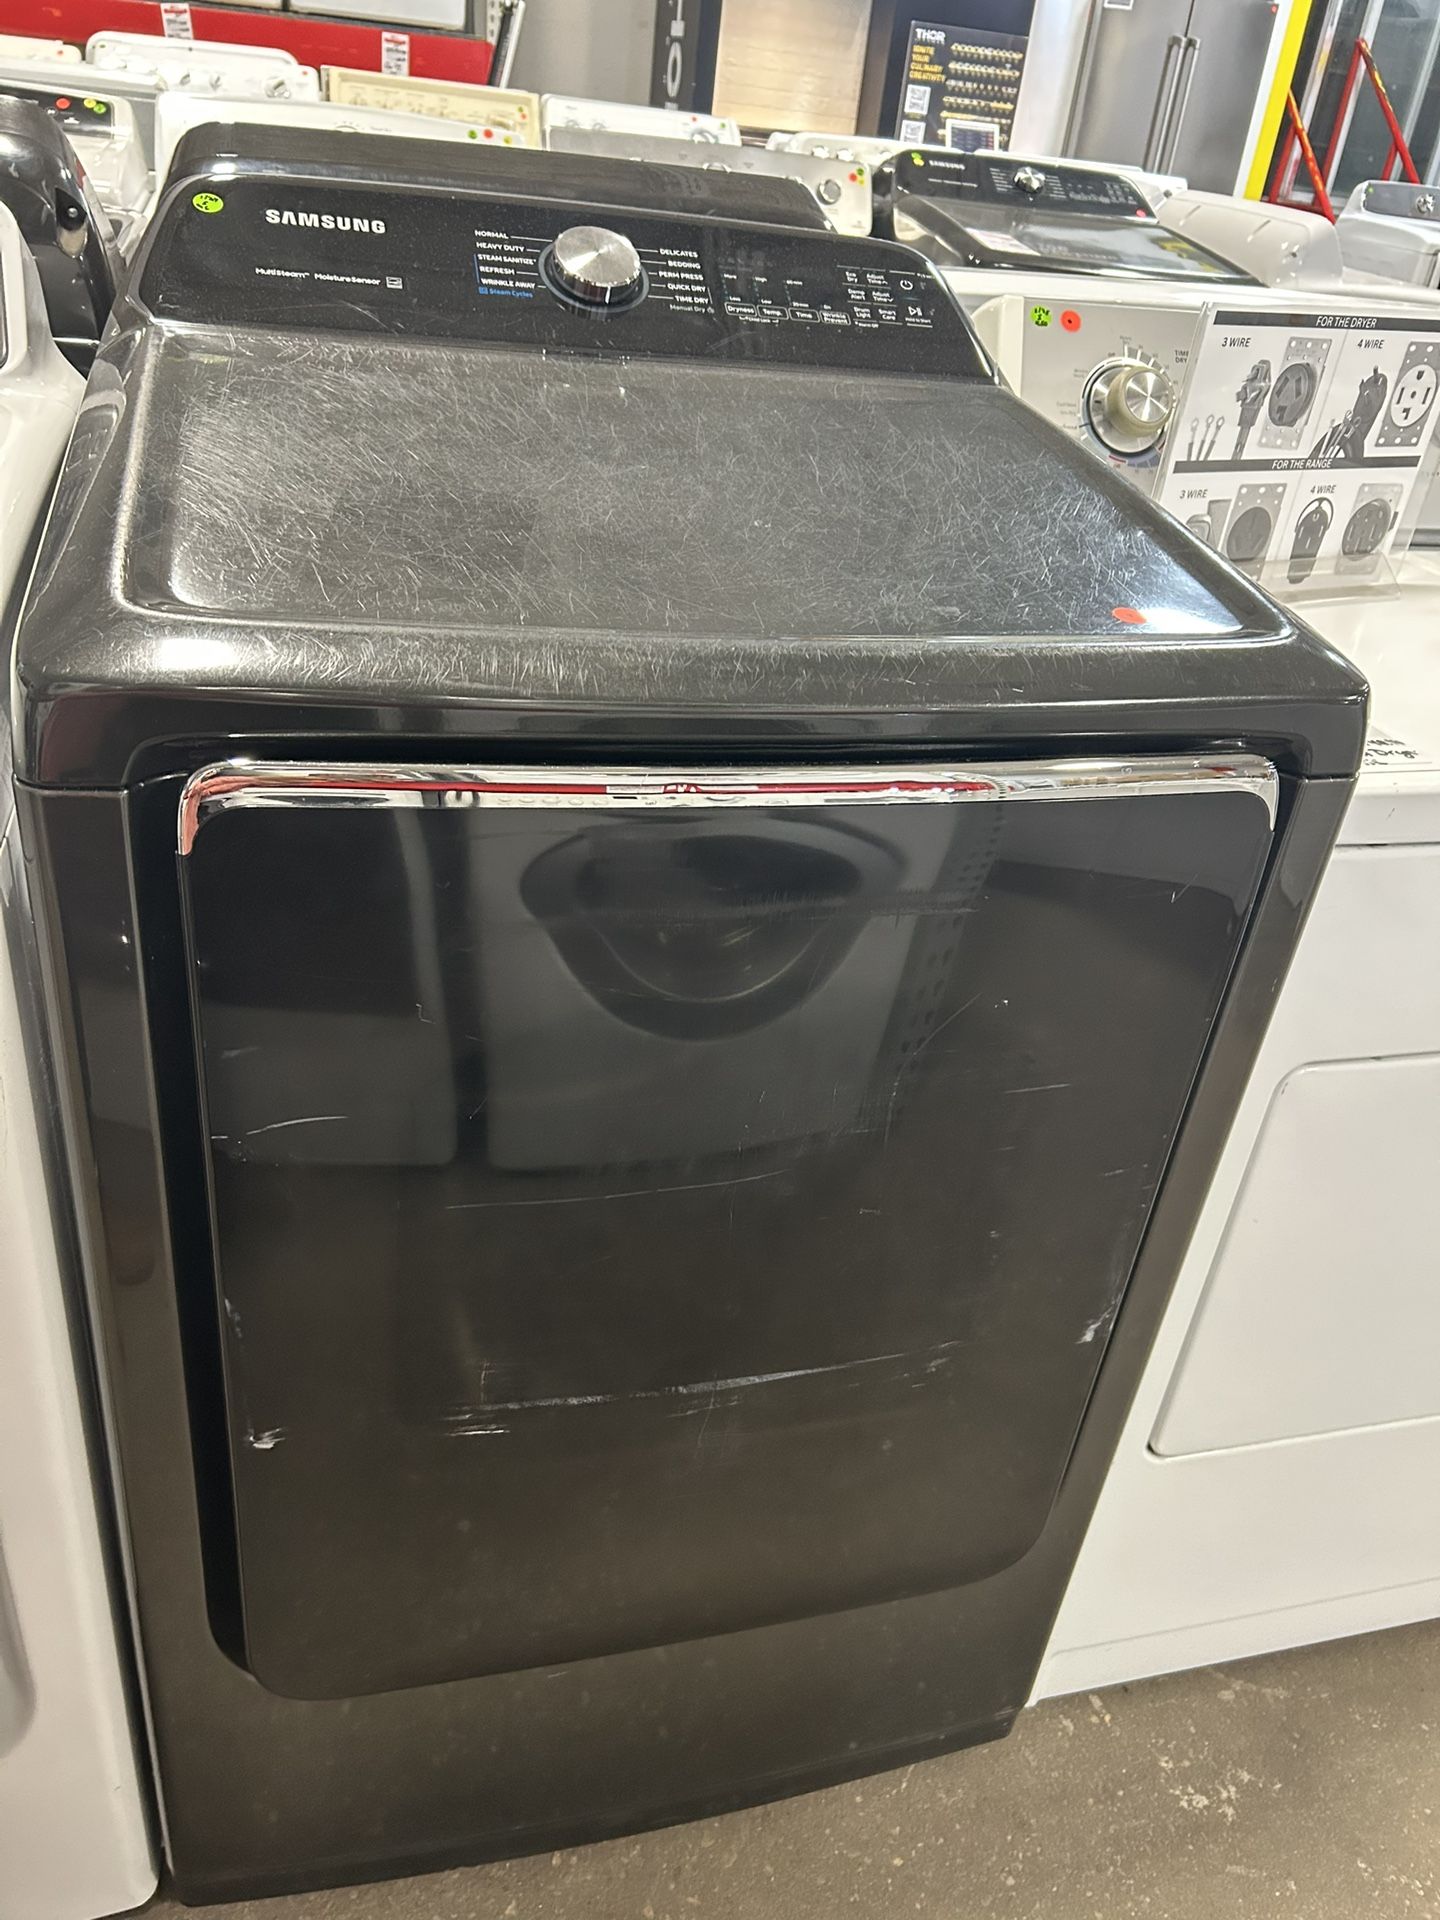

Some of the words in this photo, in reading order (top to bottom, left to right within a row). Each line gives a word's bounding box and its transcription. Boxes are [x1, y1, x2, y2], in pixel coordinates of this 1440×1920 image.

[915, 28, 946, 41] THOR
[909, 70, 946, 83] CREATIVITY
[929, 160, 965, 170] SAMSUNG
[265, 208, 387, 234] SAMSUNG
[474, 229, 509, 240] NORMAL
[476, 242, 502, 250] HEAVY
[503, 244, 525, 252] DUTY
[477, 253, 502, 262] STEAM
[659, 248, 699, 258] DELICATES
[667, 260, 701, 270] BEDDING
[479, 265, 515, 276] REFRESH
[658, 270, 680, 279] PERM
[680, 273, 704, 281] PRESS
[480, 278, 514, 287] WRINKLE
[514, 281, 536, 289] AWAY
[667, 283, 691, 291] QUICK
[511, 290, 533, 299] Cycles
[675, 295, 693, 303] TIME
[694, 297, 709, 305] DRY
[669, 304, 693, 312] Manual
[693, 305, 706, 314] Dry
[727, 305, 755, 314] Dryness
[762, 308, 783, 316] Temp.
[795, 311, 813, 319] Time
[823, 317, 848, 325] Prevent
[1315, 316, 1334, 327] FOR
[1334, 317, 1351, 328] THE
[1350, 317, 1378, 329] DRYER
[1221, 336, 1228, 348] 3
[1229, 337, 1251, 348] WIRE
[1357, 339, 1364, 348] 4
[1364, 339, 1385, 349] WIRE
[1272, 460, 1289, 470] FOR
[1288, 460, 1306, 469] THE
[1305, 459, 1333, 469] RANGE
[1179, 490, 1186, 499] 3
[1186, 489, 1208, 499] WIRE
[1310, 485, 1316, 494] 4
[1316, 484, 1337, 494] WIRE
